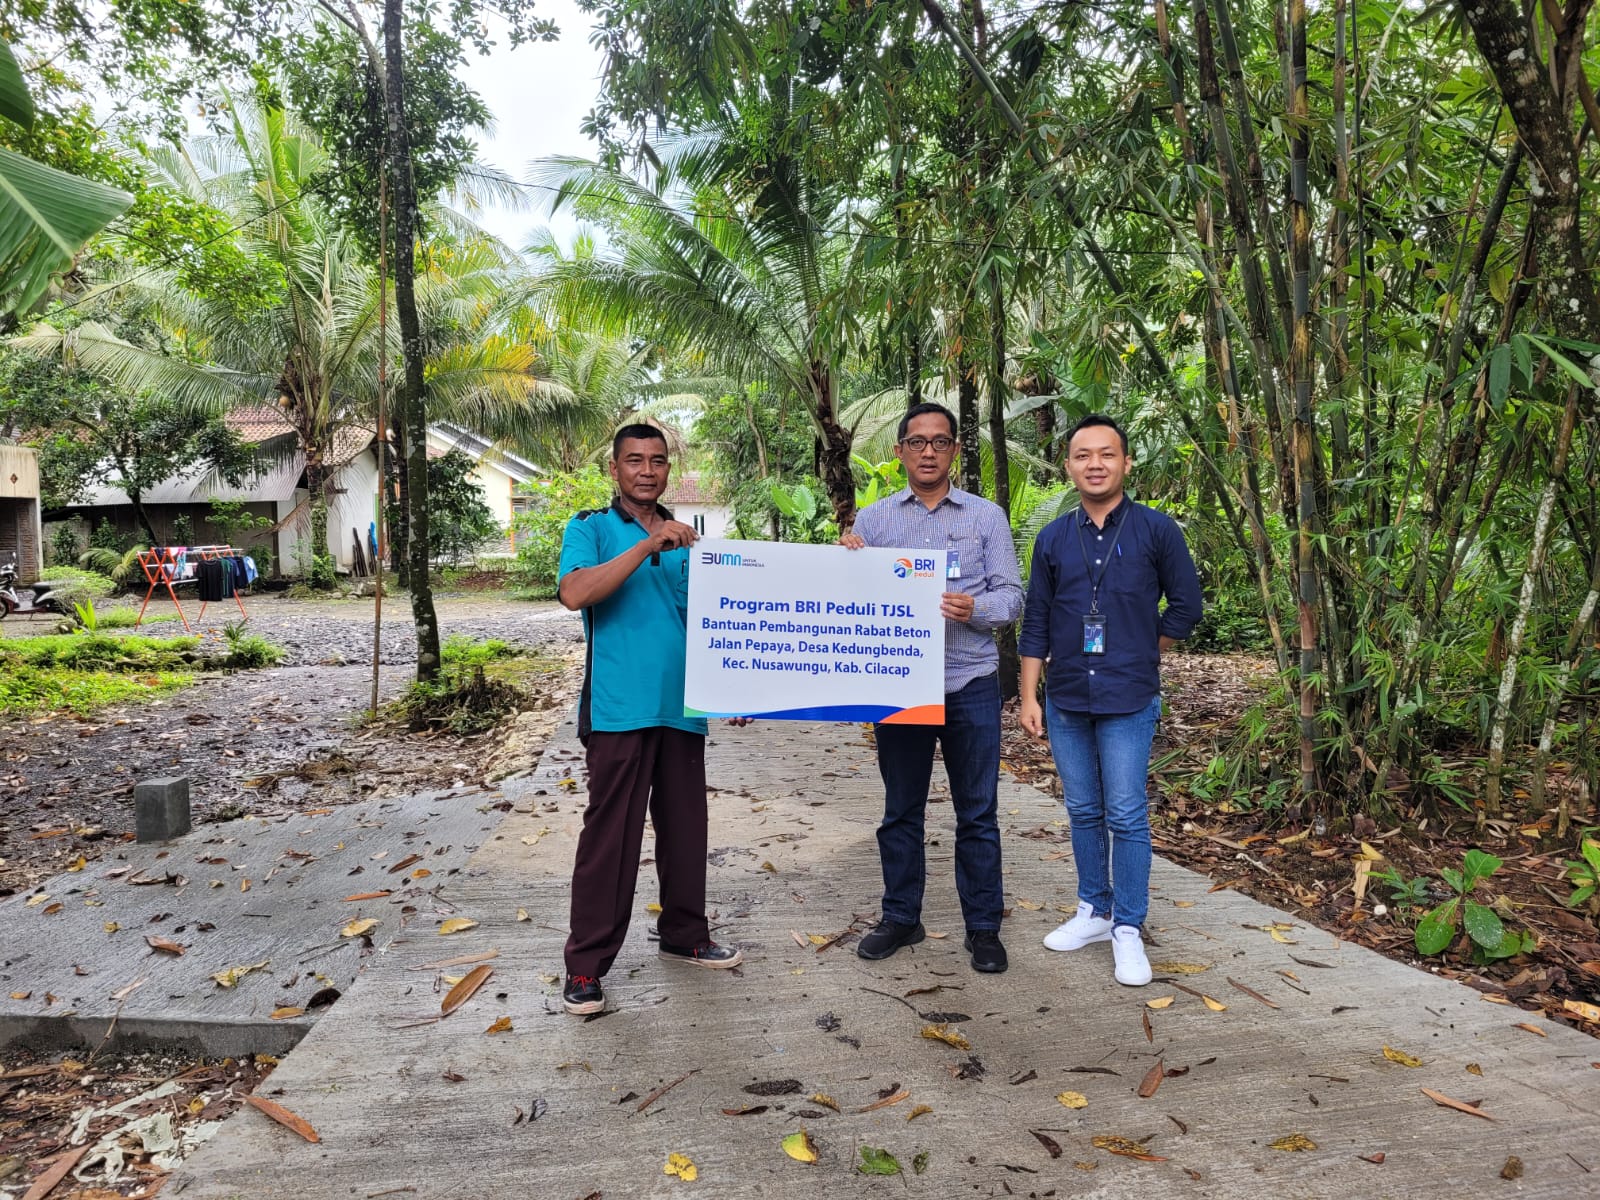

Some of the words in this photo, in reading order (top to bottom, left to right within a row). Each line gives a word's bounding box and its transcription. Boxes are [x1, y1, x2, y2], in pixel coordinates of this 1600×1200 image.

[914, 558, 935, 571] BRI
[720, 597, 790, 614] Program
[795, 600, 821, 614] BRI
[826, 601, 876, 616] Peduli
[881, 604, 915, 618] TJSL
[702, 617, 756, 631] Bantuan
[760, 620, 852, 637] Pembangunan
[855, 624, 892, 637] Rabat
[894, 626, 931, 638] Beton
[708, 637, 742, 650] Jalan
[745, 639, 795, 654] Pepaya,
[798, 641, 829, 654] Desa
[832, 642, 924, 658] Kedungbenda,
[722, 657, 749, 669] Kec.
[752, 658, 831, 675] Nusawungu,
[834, 661, 862, 674] Kab.
[864, 663, 911, 678] Cilacap
